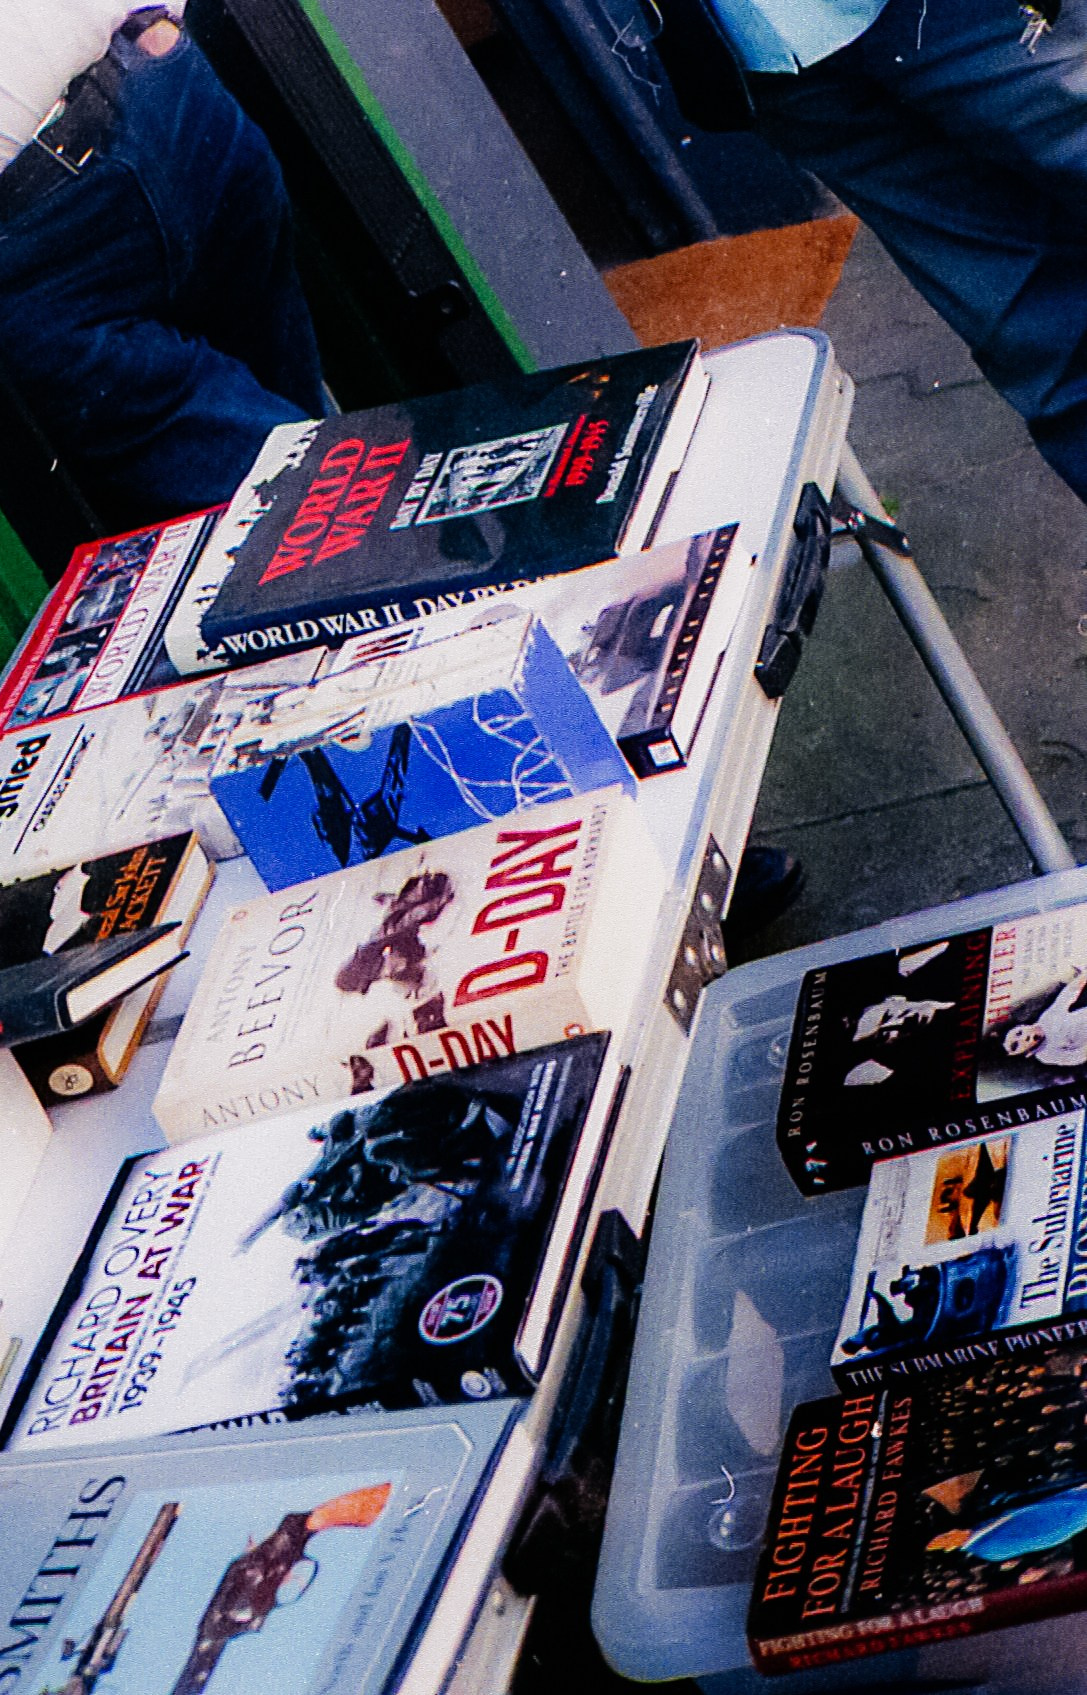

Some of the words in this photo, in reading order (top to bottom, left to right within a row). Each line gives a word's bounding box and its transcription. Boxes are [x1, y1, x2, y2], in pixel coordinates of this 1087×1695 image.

[258, 438, 366, 586] WORLD
[312, 470, 396, 566] WAR
[360, 437, 411, 473] II
[80, 607, 149, 704] WORLD
[133, 544, 182, 602] WAR
[221, 618, 319, 655] WORLD
[319, 608, 384, 638] WAR
[384, 603, 403, 626] II
[119, 856, 167, 929] ACKETT
[453, 820, 583, 1007] D-DAY
[228, 891, 319, 1068] BEEVOR
[950, 932, 988, 1101] EXPLAINING
[987, 925, 1018, 1024] HITLER
[203, 1074, 321, 1129] ANTONY
[393, 1014, 516, 1085] D-DAY
[787, 1096, 805, 1138] RON
[796, 971, 827, 1085] ROSENBAUM
[862, 1130, 915, 1156] RON
[928, 1093, 1087, 1141] ROSENBAUM
[154, 1155, 210, 1237] WAR
[1028, 1122, 1078, 1255] Submarine
[27, 1285, 122, 1436] RICHARD
[104, 1170, 172, 1277] OVERY
[138, 1246, 172, 1280] AT
[1019, 1257, 1060, 1309] The
[69, 1291, 153, 1426] BRITAIN
[118, 1276, 197, 1414] 1939-1945
[846, 1365, 884, 1387] THE
[890, 1339, 999, 1375] SUBMARINE
[762, 1426, 828, 1602] FIGHTING
[824, 1393, 875, 1515] LAUGH
[859, 1490, 899, 1592] RICHARD
[882, 1396, 912, 1480] FAWKES
[802, 1546, 849, 1620] FOR
[822, 1517, 854, 1540] A
[759, 1624, 854, 1657] FIGHTING
